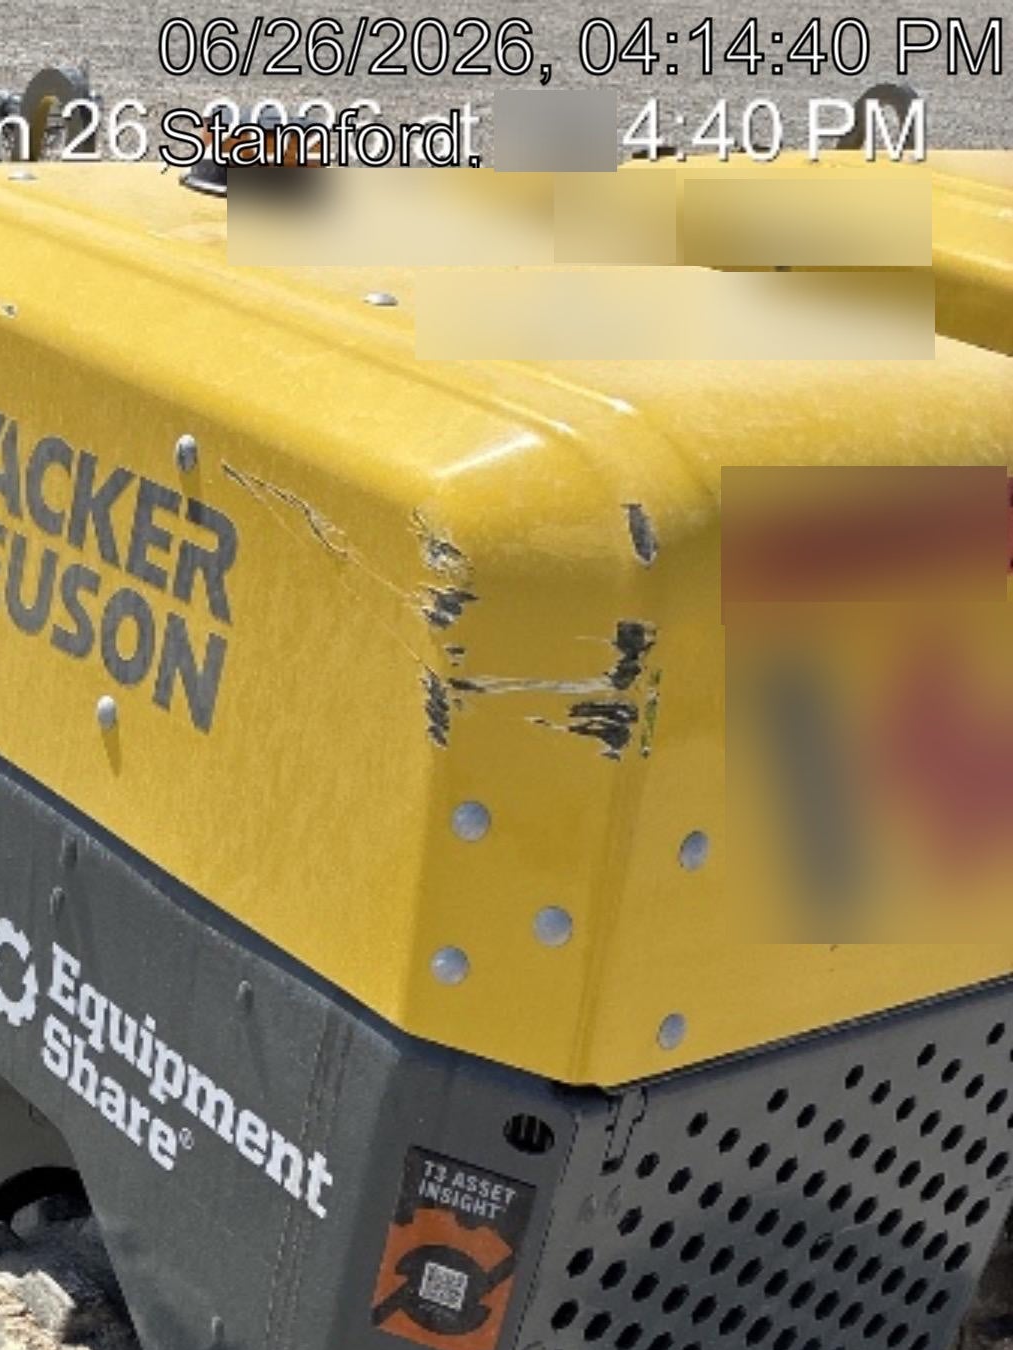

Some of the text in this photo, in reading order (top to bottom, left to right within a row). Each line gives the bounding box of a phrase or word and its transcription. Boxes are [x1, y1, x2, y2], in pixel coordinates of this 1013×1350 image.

[47, 941, 334, 1219] Equipment
[418, 1179, 502, 1219] INSIGHT
[423, 1160, 517, 1204] T3 ASSET
